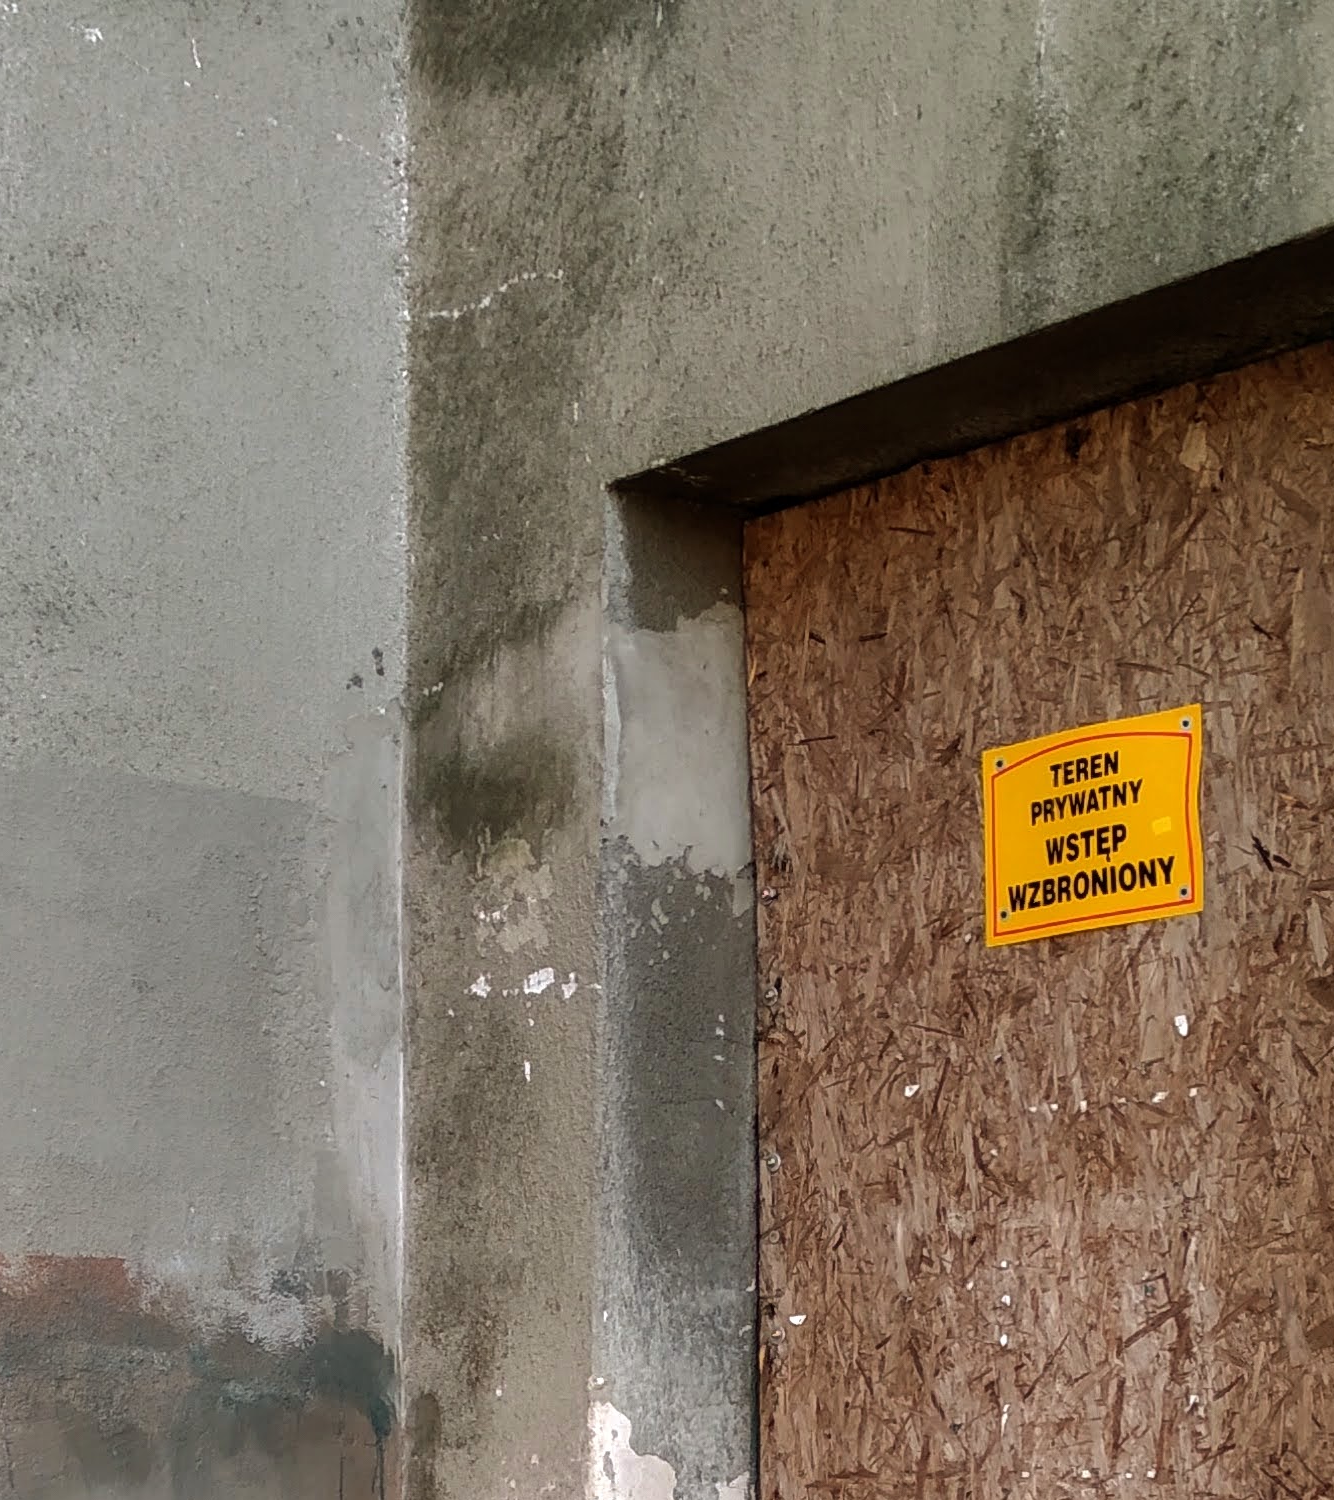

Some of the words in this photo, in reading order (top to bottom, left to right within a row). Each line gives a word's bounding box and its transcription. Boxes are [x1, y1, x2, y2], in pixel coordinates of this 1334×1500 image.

[1050, 751, 1119, 787] TEREN
[1031, 779, 1143, 826] PRYWATNY
[1046, 824, 1127, 866] WSTĘP
[1008, 856, 1175, 912] WZBRONIONY
